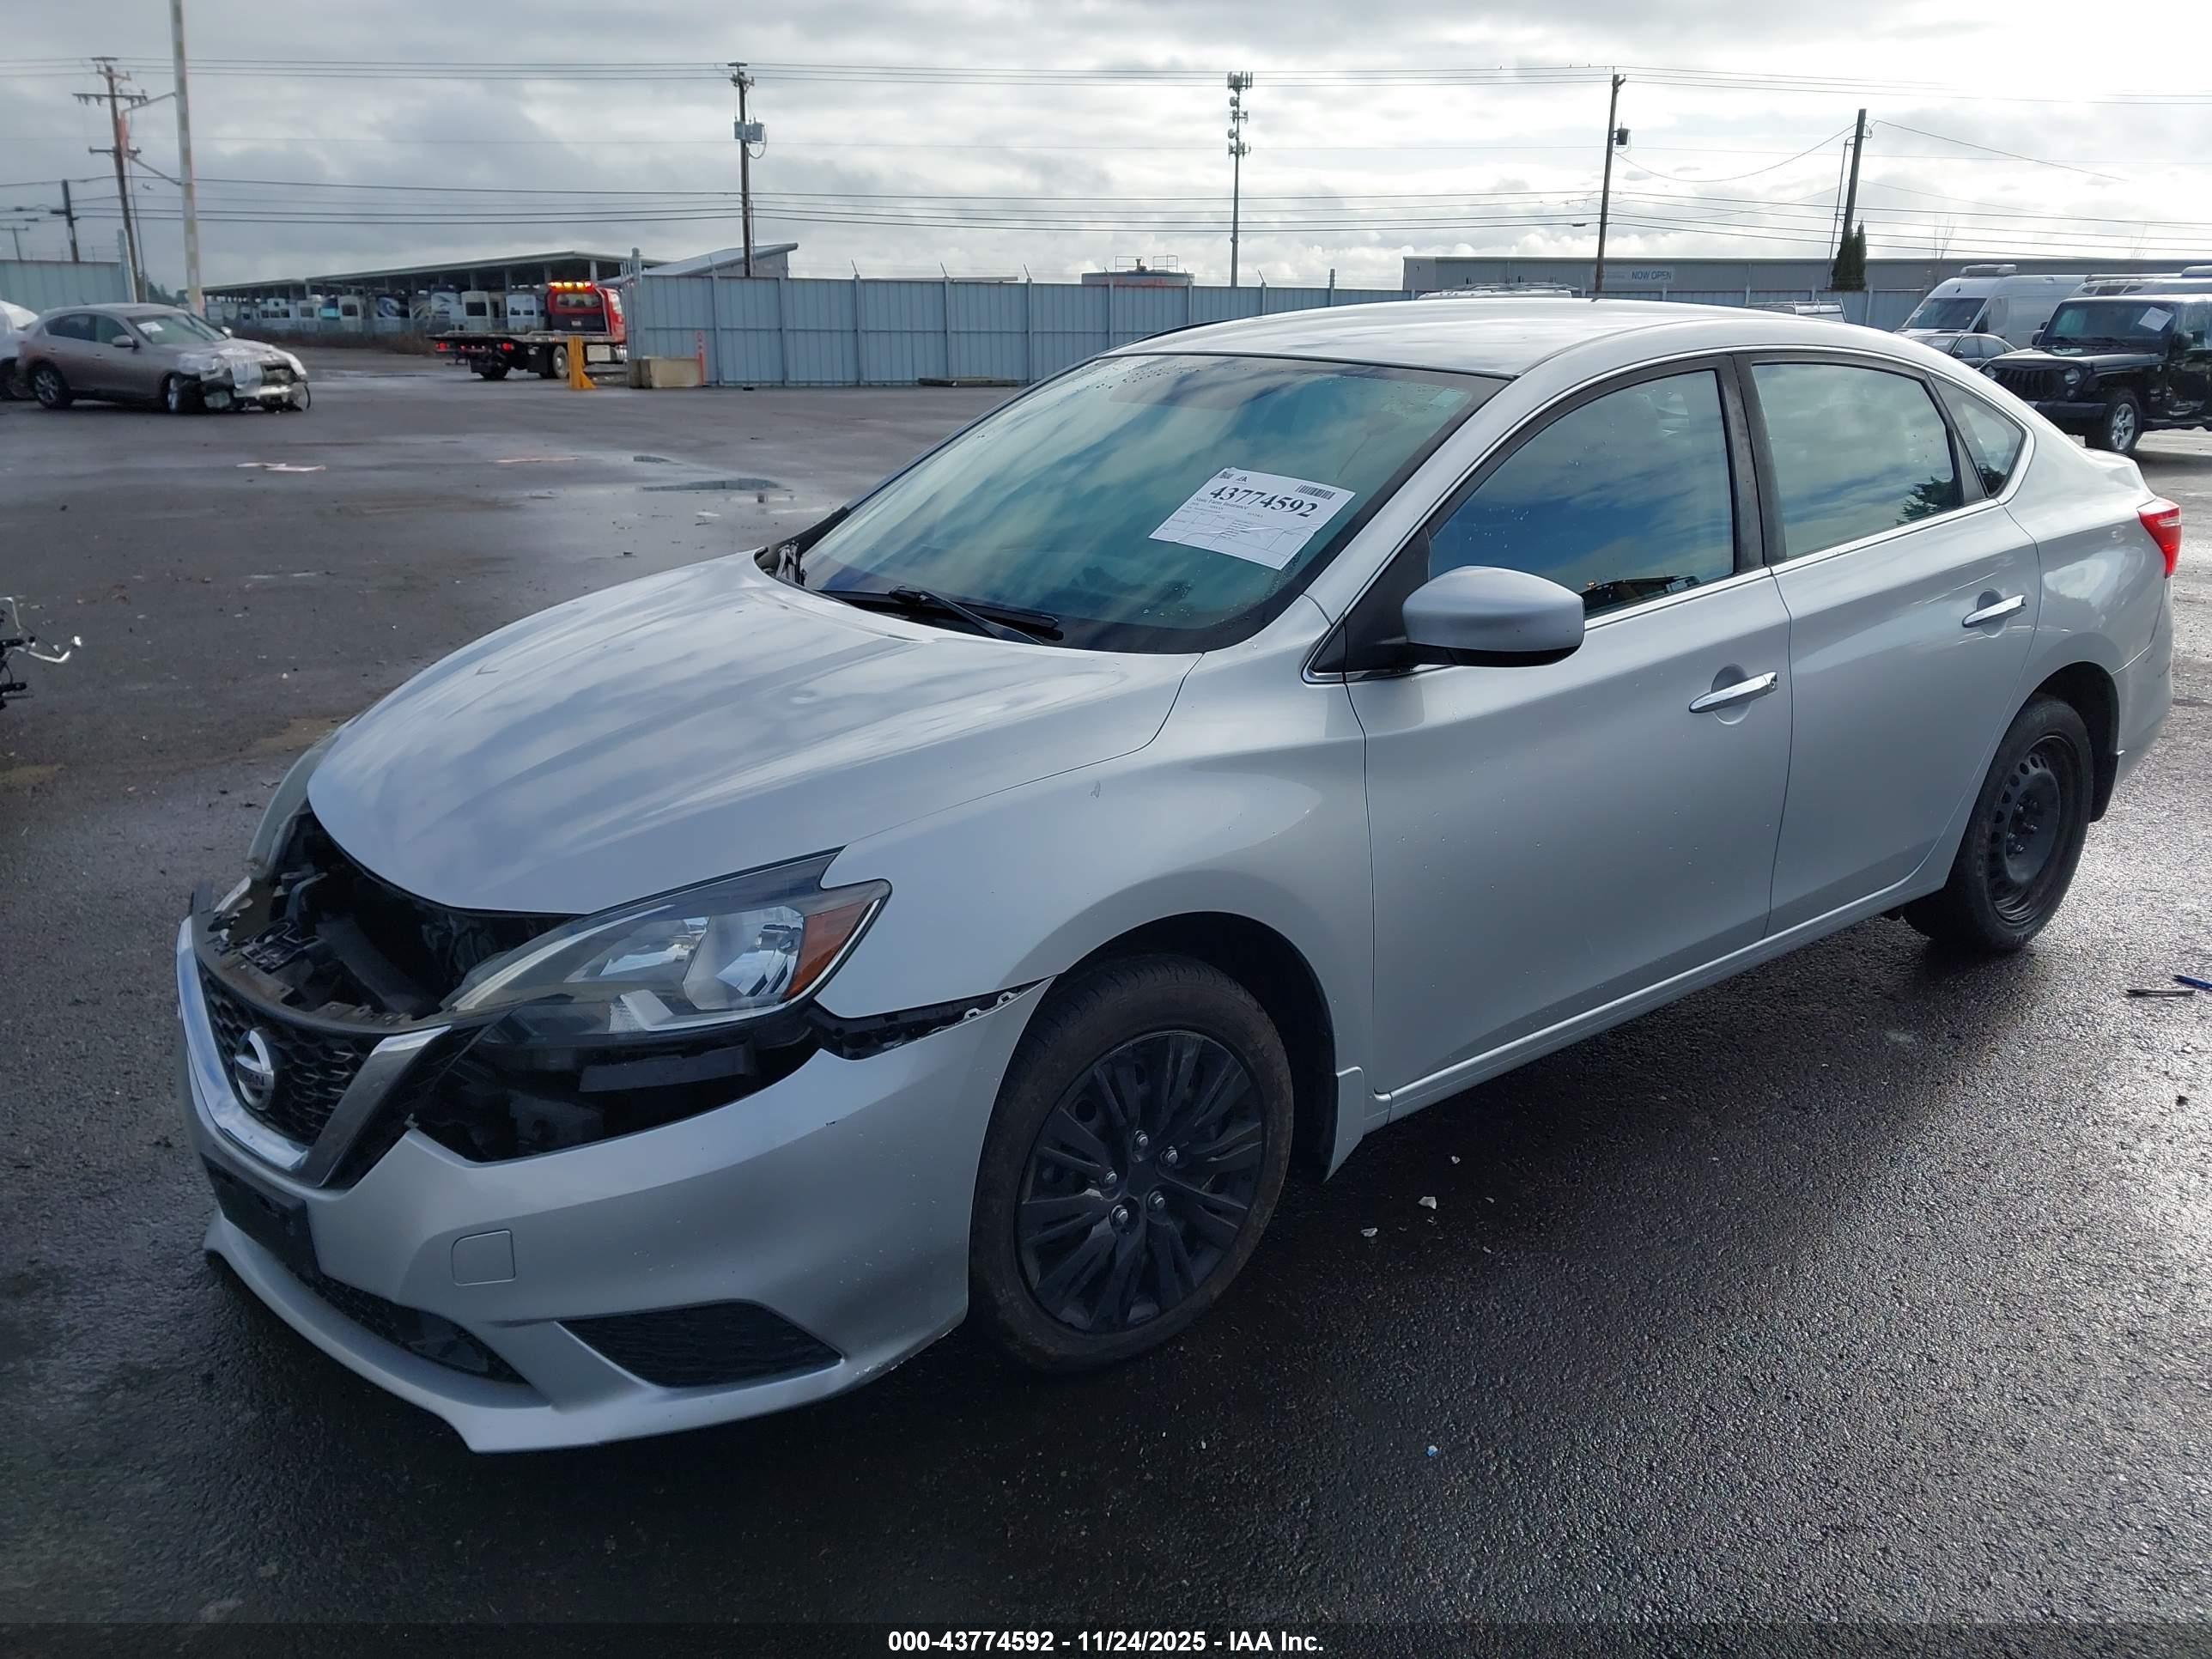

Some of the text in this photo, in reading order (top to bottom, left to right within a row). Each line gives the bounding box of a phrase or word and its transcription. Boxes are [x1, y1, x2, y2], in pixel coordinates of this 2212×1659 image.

[1632, 270, 1650, 280] NOW
[1650, 270, 1672, 280] OPEN
[1209, 485, 1318, 518] 43774592
